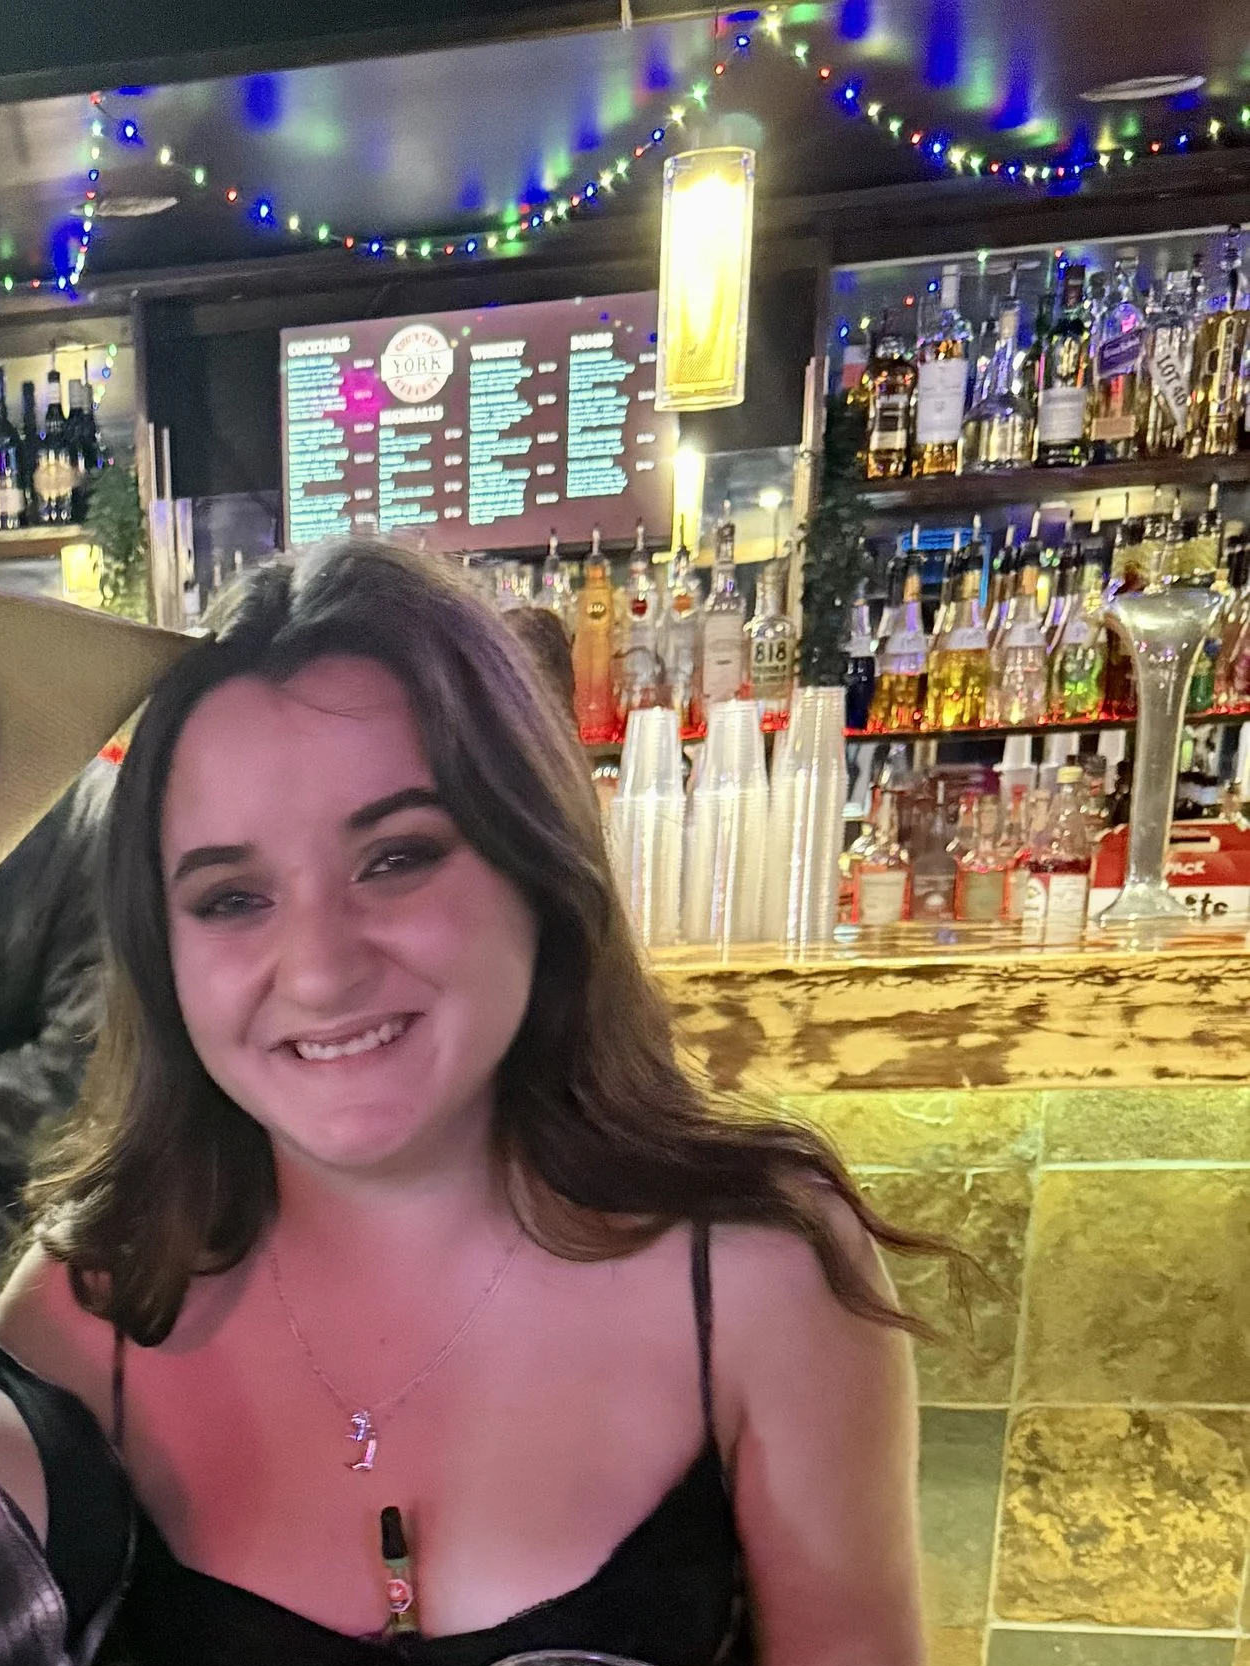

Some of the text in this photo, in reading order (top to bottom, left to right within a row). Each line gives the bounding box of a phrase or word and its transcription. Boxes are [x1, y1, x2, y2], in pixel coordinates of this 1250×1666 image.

[393, 355, 441, 374] YORK
[1156, 354, 1180, 384] LOT
[755, 641, 787, 664] 818
